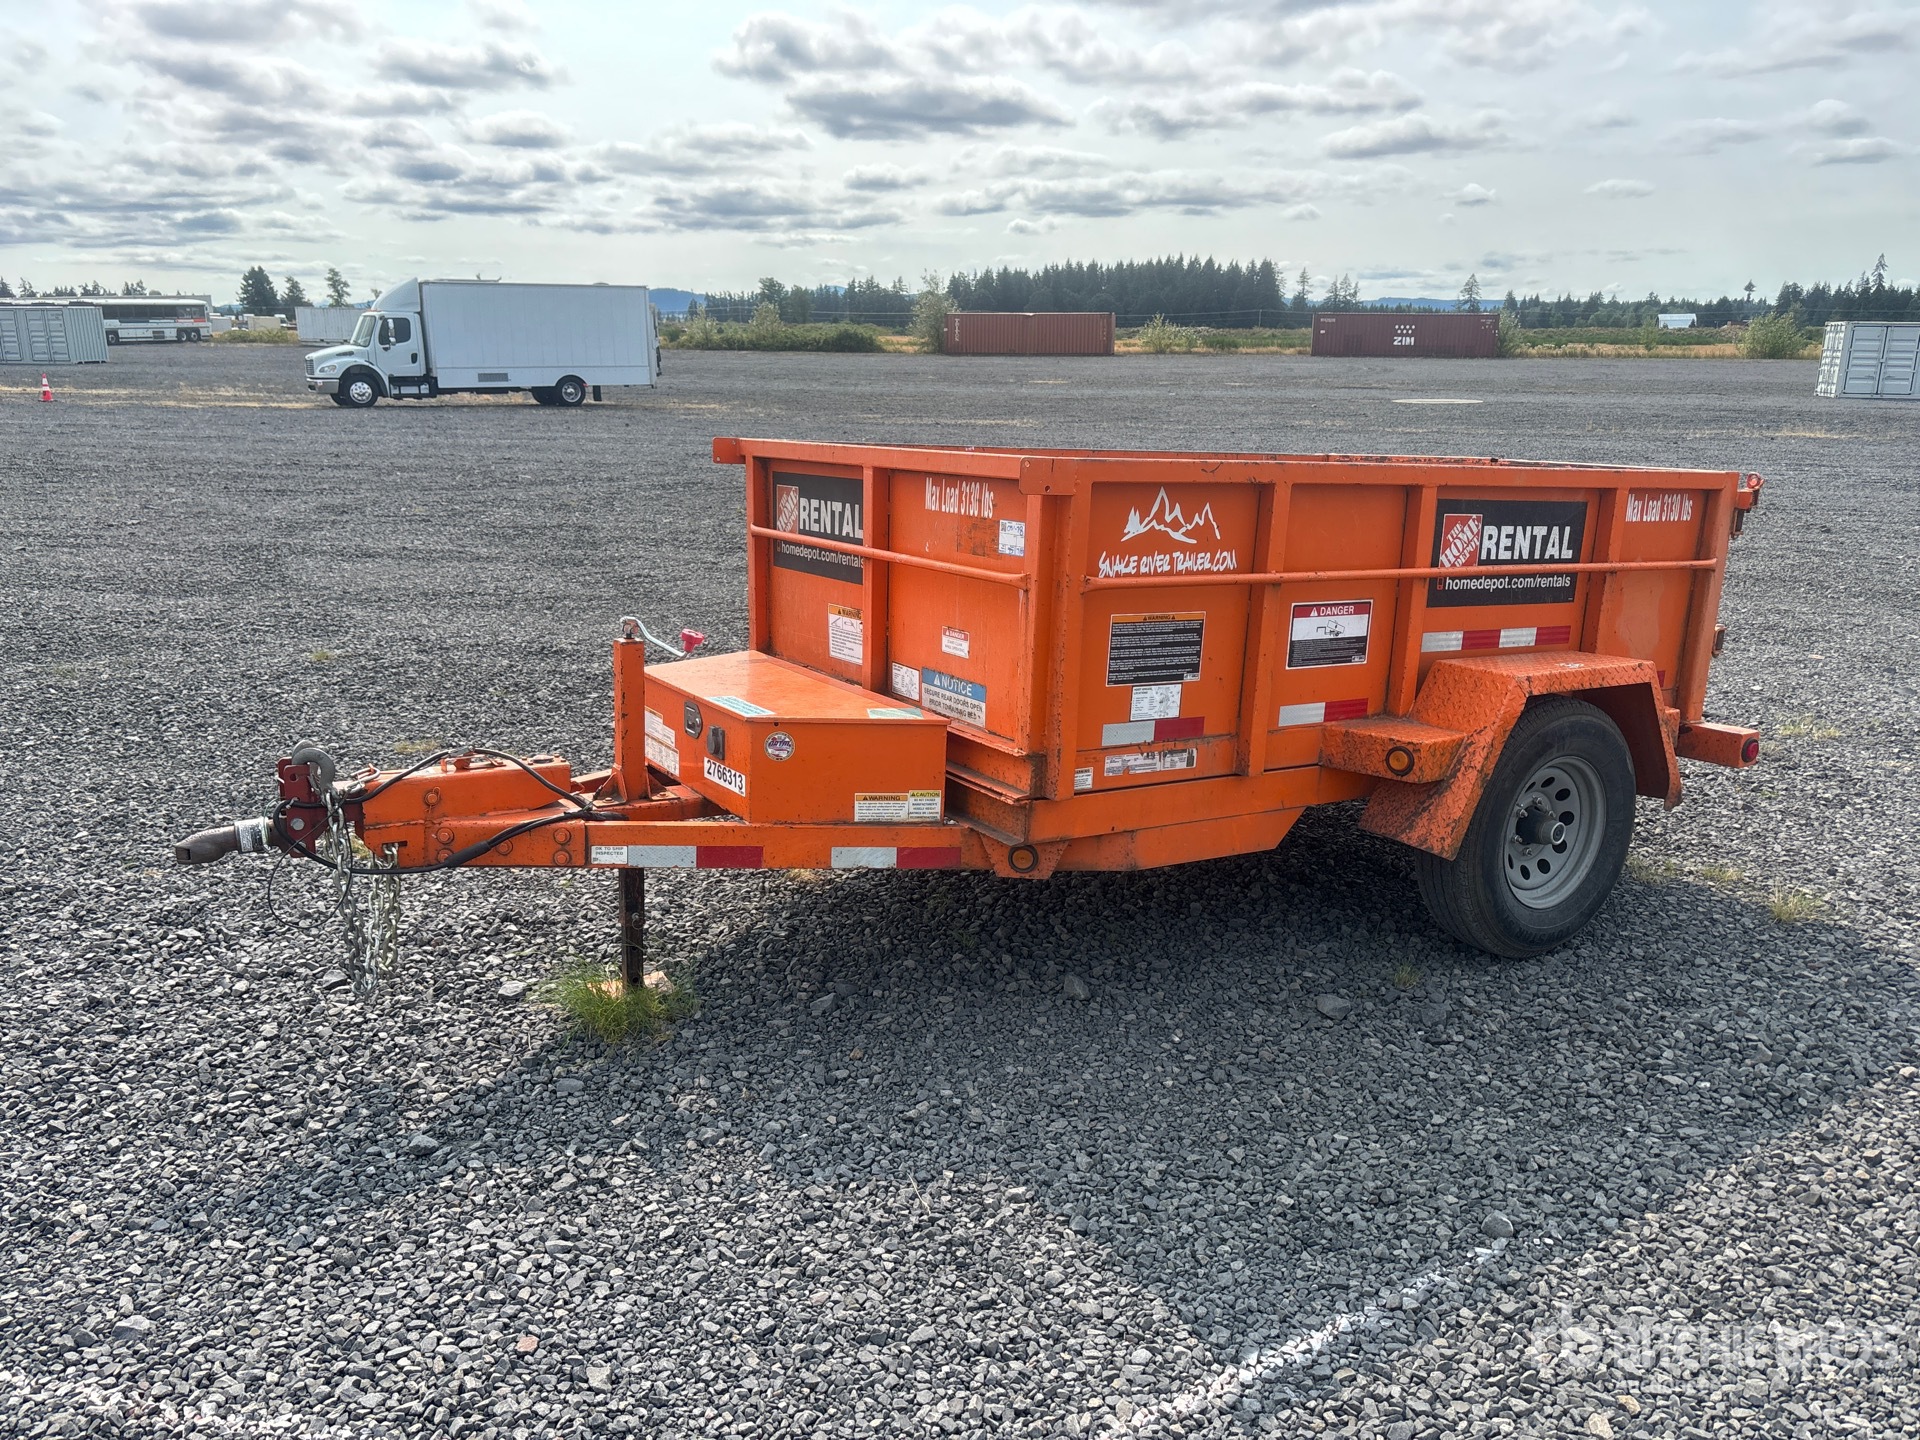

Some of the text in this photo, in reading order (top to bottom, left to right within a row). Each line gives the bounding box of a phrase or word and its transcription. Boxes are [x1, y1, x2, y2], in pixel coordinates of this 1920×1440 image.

[1392, 336, 1415, 346] ZIM
[925, 477, 994, 519] Max Load 3130 lbs
[1626, 494, 1693, 522] Max Load 3130 lbs
[800, 497, 864, 539] RENTAL
[1446, 521, 1463, 542] THE
[781, 541, 864, 568] homedepot.com/rentals
[1440, 515, 1481, 568] HOME
[1455, 535, 1480, 568] DEPOT
[1480, 526, 1573, 560] RENTAL
[1098, 550, 1138, 578] SNAKE
[1140, 550, 1170, 576] RIVER
[1445, 574, 1572, 592] homedepot.com/rentals
[1320, 606, 1354, 616] DANGER
[949, 630, 964, 640] DANGER
[942, 676, 972, 696] NOTICE
[924, 687, 982, 713] SECURE REAR DOORS OPEN
[928, 698, 942, 708] PRIOR
[706, 760, 744, 790] 2766313
